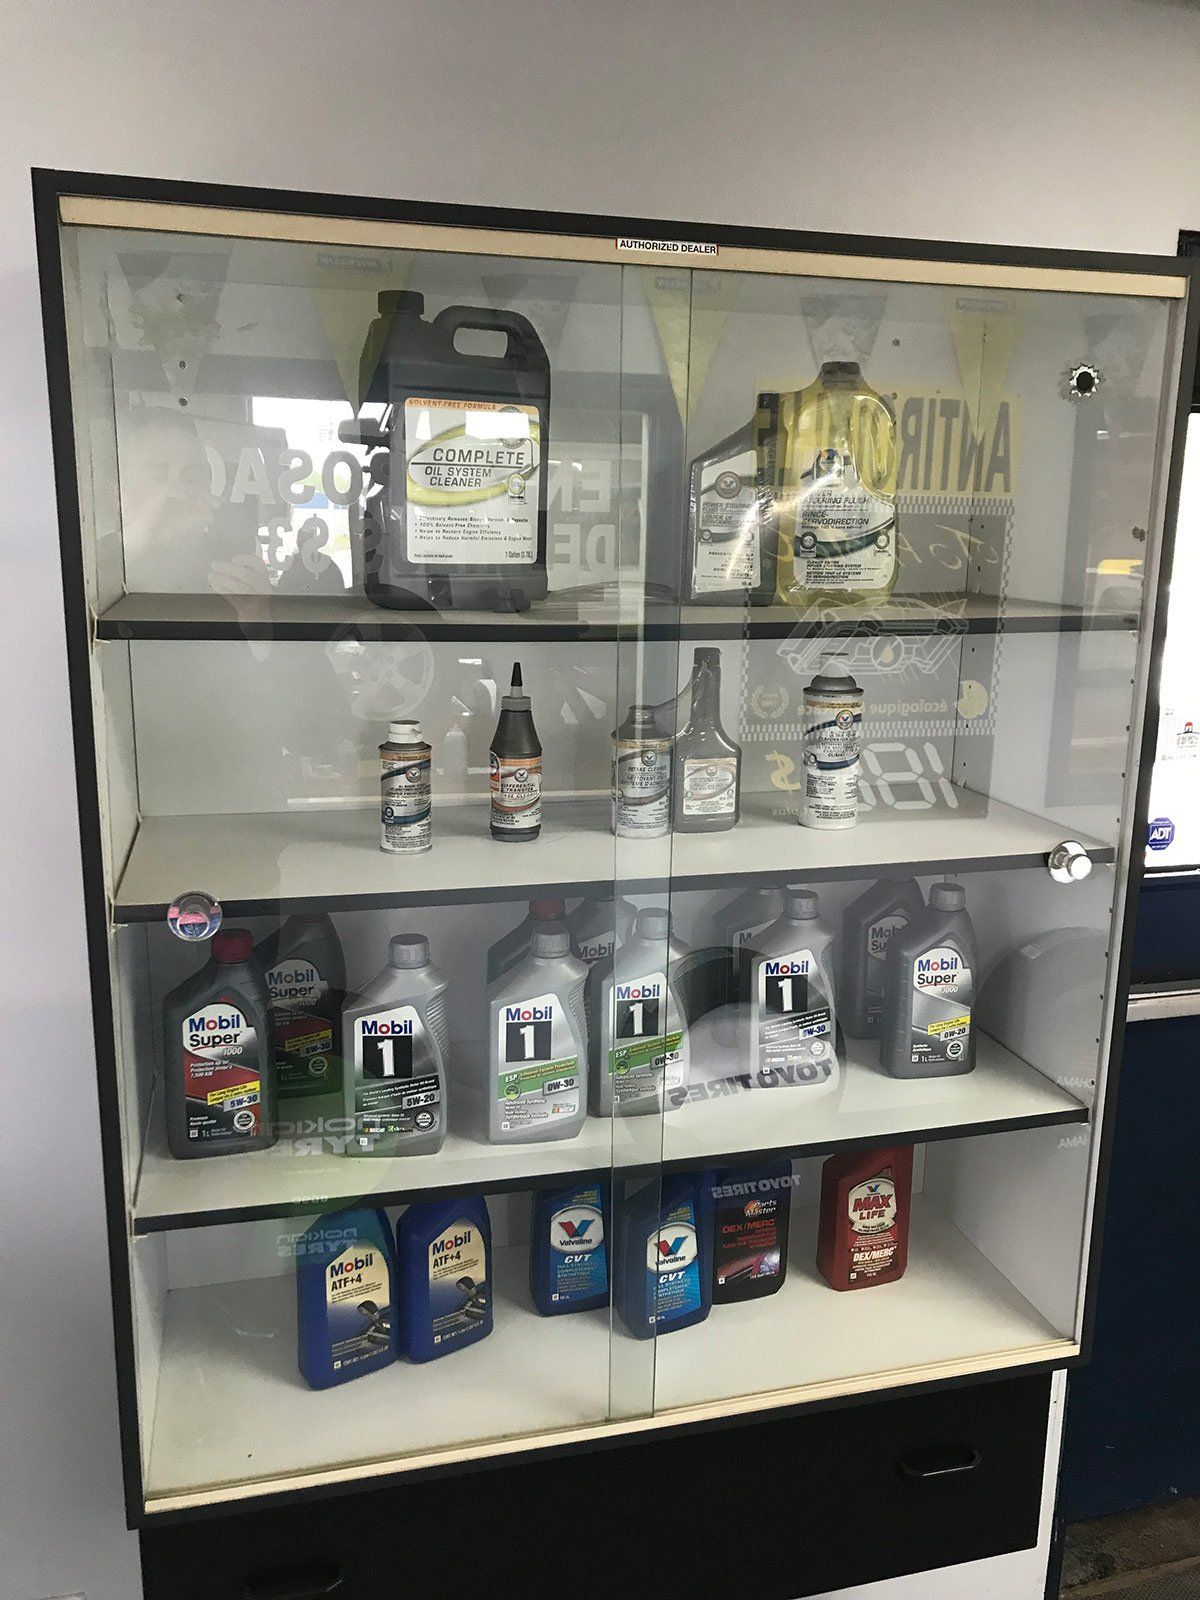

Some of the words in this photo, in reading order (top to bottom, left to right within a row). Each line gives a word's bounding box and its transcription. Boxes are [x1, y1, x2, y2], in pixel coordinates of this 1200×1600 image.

[619, 239, 679, 252] AUTHORIZED
[680, 244, 716, 254] DEALER
[408, 399, 461, 409] SOLVENT-FREE
[463, 402, 497, 411] FORMULA
[433, 447, 525, 466] COMPLETE
[424, 465, 443, 476] OIL
[447, 466, 492, 478] SYSTEM
[429, 476, 482, 488] CLEANER
[801, 517, 870, 525] SERVODIRECTION
[1151, 826, 1171, 841] ADT
[765, 960, 809, 975] Mobil
[917, 957, 958, 972] Mobil
[268, 968, 315, 985] Mobil
[917, 973, 957, 986] Super
[269, 985, 315, 999] Super
[616, 983, 660, 1000] Mobil
[777, 977, 793, 1012] 1
[506, 1006, 553, 1022] Mobil
[628, 1001, 644, 1036] 1
[189, 1014, 240, 1033] Mobil
[361, 1020, 413, 1036] Mobil
[802, 1024, 826, 1038] 5W-30
[189, 1032, 241, 1048] Super
[943, 1026, 966, 1039] 0W-20
[519, 1024, 535, 1060] 1
[223, 1046, 243, 1056] 1000
[376, 1038, 395, 1077] 1
[505, 1073, 518, 1083] ESP
[547, 1078, 575, 1091] 0W-30
[229, 1094, 258, 1108] 5W-30
[406, 1093, 435, 1107] 5W-20
[754, 1199, 778, 1208] Parts
[852, 1194, 894, 1213] MAX
[745, 1206, 777, 1217] Master
[859, 1209, 886, 1221] LIFE
[722, 1218, 775, 1234] DEX/MERC
[432, 1230, 472, 1256] Mobil
[559, 1237, 593, 1247] Valvoline
[432, 1250, 462, 1269] ATF+4
[564, 1253, 592, 1264] CVT
[853, 1248, 894, 1262] DEX/MERC
[330, 1252, 374, 1279] Mobil
[330, 1273, 363, 1292] ATF+4
[659, 1270, 686, 1284] CVT
